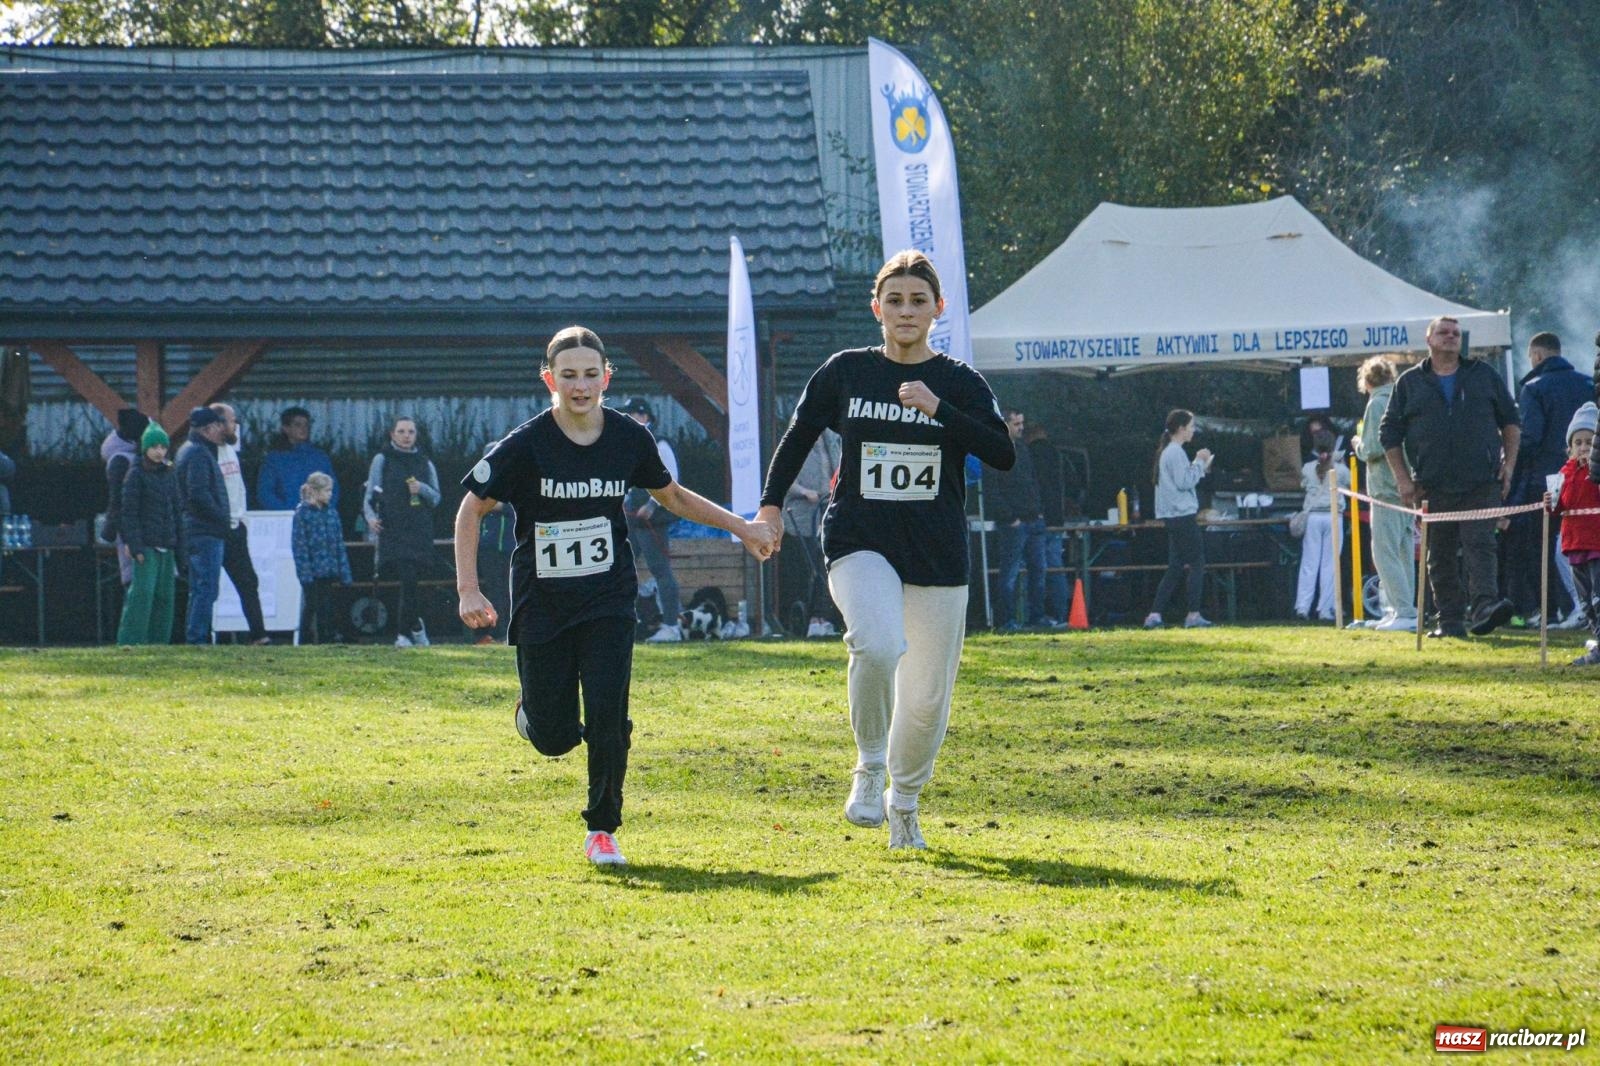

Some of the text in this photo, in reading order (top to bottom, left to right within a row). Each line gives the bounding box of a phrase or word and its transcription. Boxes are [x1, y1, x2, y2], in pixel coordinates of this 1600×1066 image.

[1015, 325, 1409, 362] STOWARZYSZENIE AKTYWNI DLA LEPSZEGO JUTRA
[867, 463, 936, 490] 104
[542, 537, 609, 568] 113
